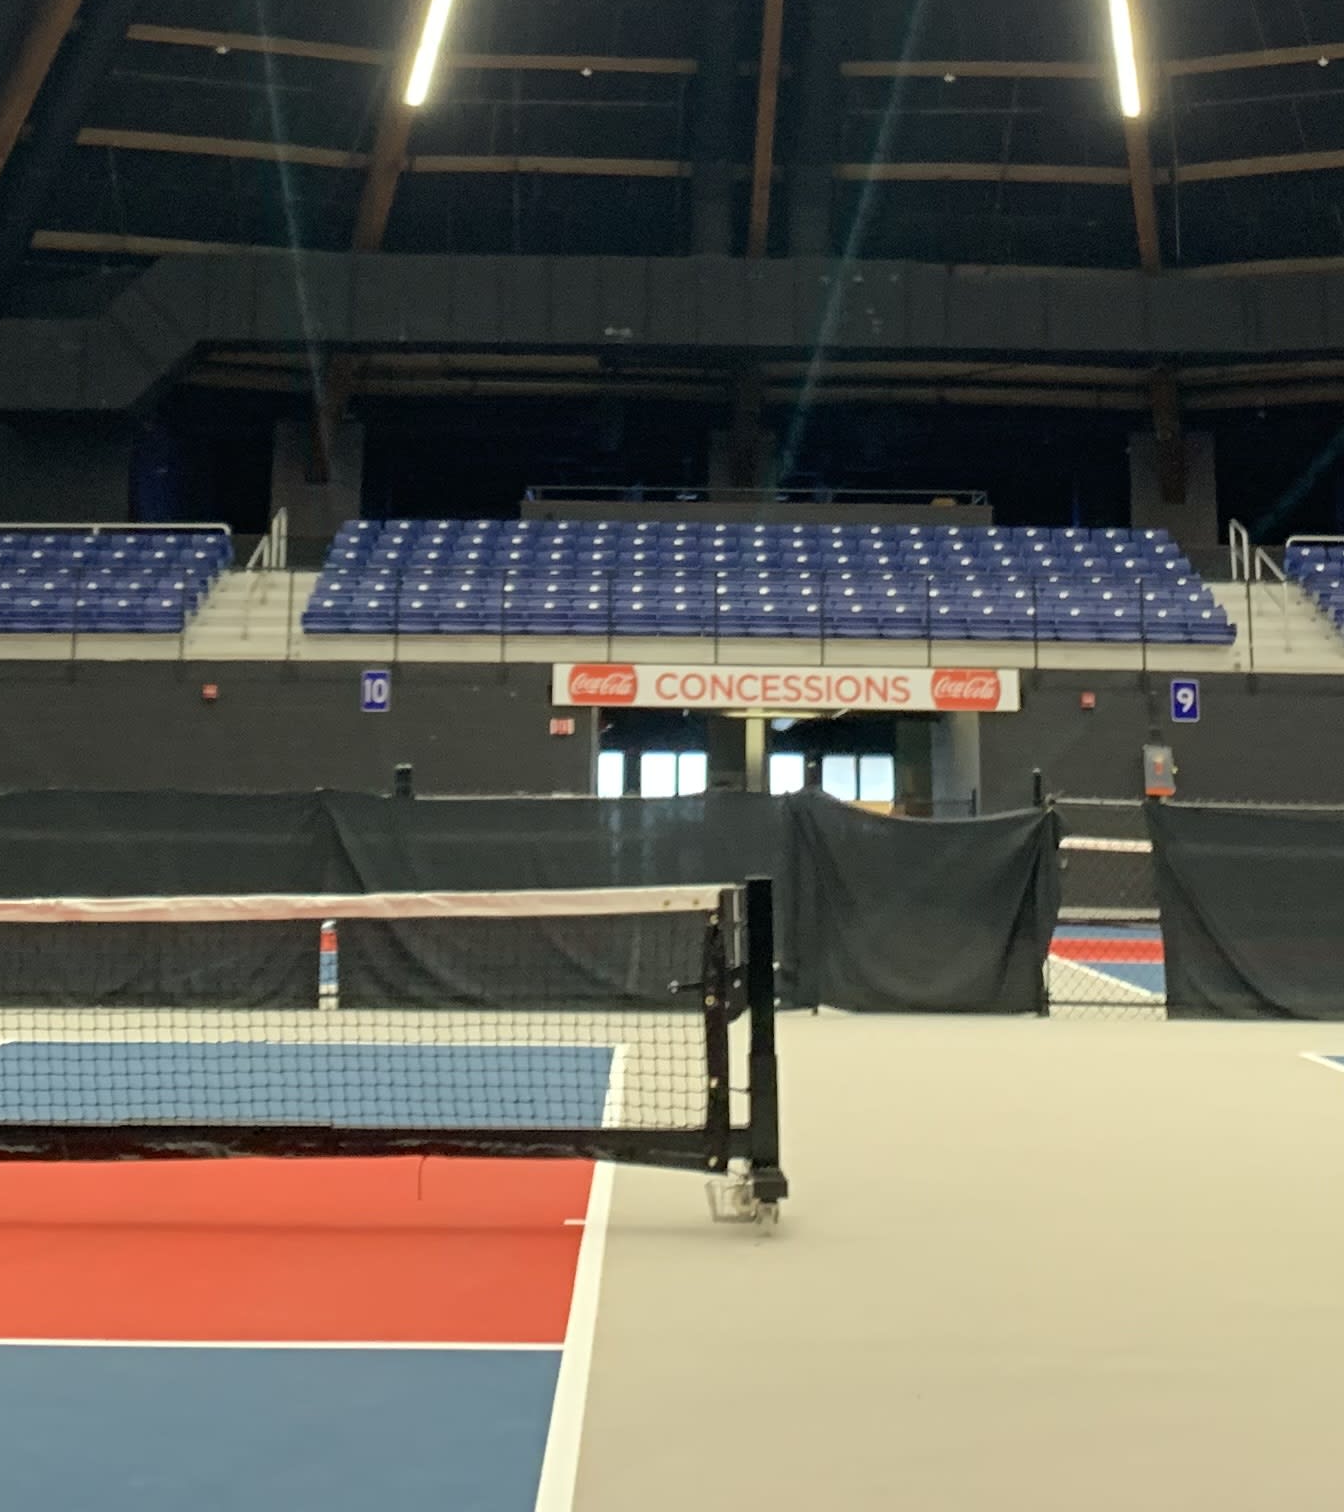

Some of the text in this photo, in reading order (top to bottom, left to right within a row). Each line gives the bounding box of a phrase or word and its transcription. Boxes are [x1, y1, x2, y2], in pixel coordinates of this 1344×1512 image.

[364, 679, 388, 703] 10
[655, 672, 911, 704] CONCESSIONS
[1176, 687, 1194, 713] 9
